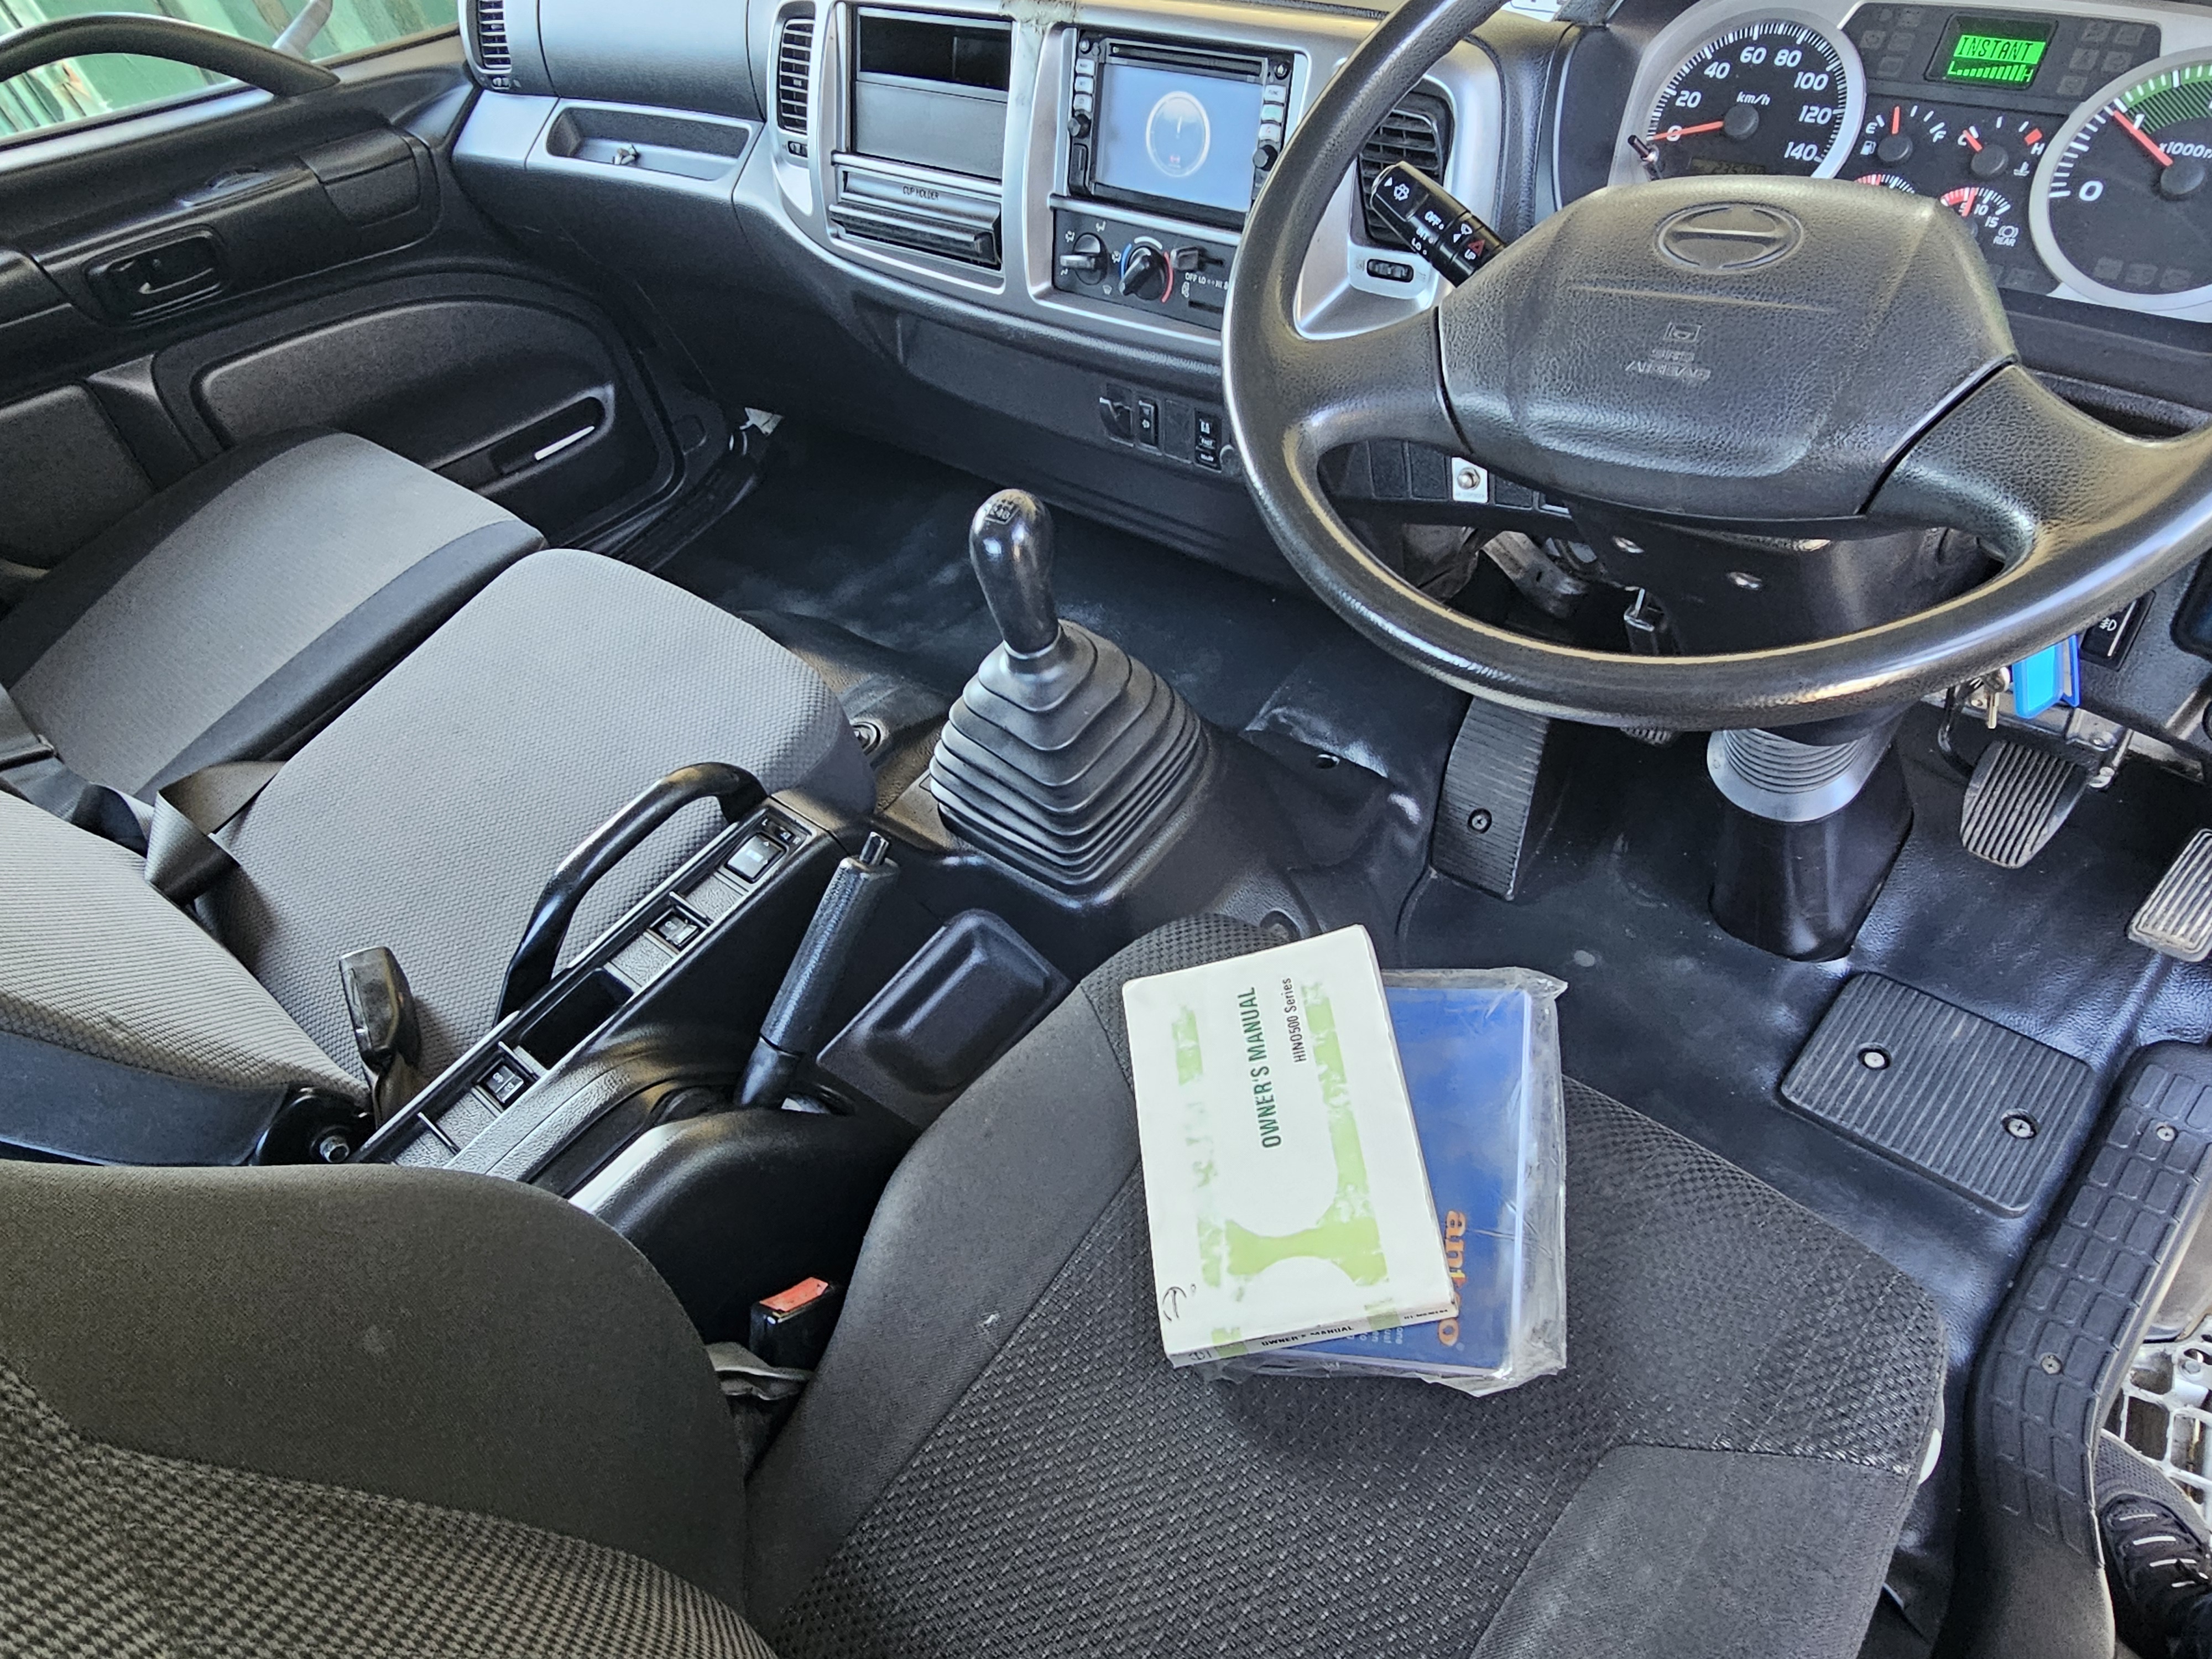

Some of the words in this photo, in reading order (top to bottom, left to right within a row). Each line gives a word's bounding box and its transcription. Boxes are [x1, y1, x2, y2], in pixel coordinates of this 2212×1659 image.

[1740, 46, 1766, 64] 60
[1957, 36, 2033, 61] INSTANT
[1774, 49, 1802, 67] 80
[1704, 61, 1730, 79] 40
[1793, 71, 1829, 91] 100
[1675, 90, 1702, 108] 20
[1736, 91, 1770, 106] km/h
[1798, 105, 1832, 124] 120
[1666, 125, 1682, 142] 0
[1865, 122, 1878, 134] E
[1932, 131, 1947, 142] F
[1957, 133, 1968, 146] C
[1784, 142, 1817, 161] 140
[2031, 143, 2044, 155] H
[2079, 180, 2104, 201] 0
[1425, 211, 1442, 226] OFF
[1974, 204, 1989, 215] 10
[1985, 216, 2000, 228] 15
[1411, 237, 1421, 251] LO
[1992, 236, 2016, 247] REAR
[1464, 248, 1477, 260] UP
[1281, 977, 1297, 1013] Series
[1237, 987, 1267, 1062] MANUAL
[1287, 1015, 1307, 1063] HINO500
[1250, 1066, 1281, 1149] OWNER'S
[1438, 1209, 1467, 1347] anto
[1261, 1333, 1306, 1347] OWNER'S
[1310, 1326, 1354, 1336] MANUAL
